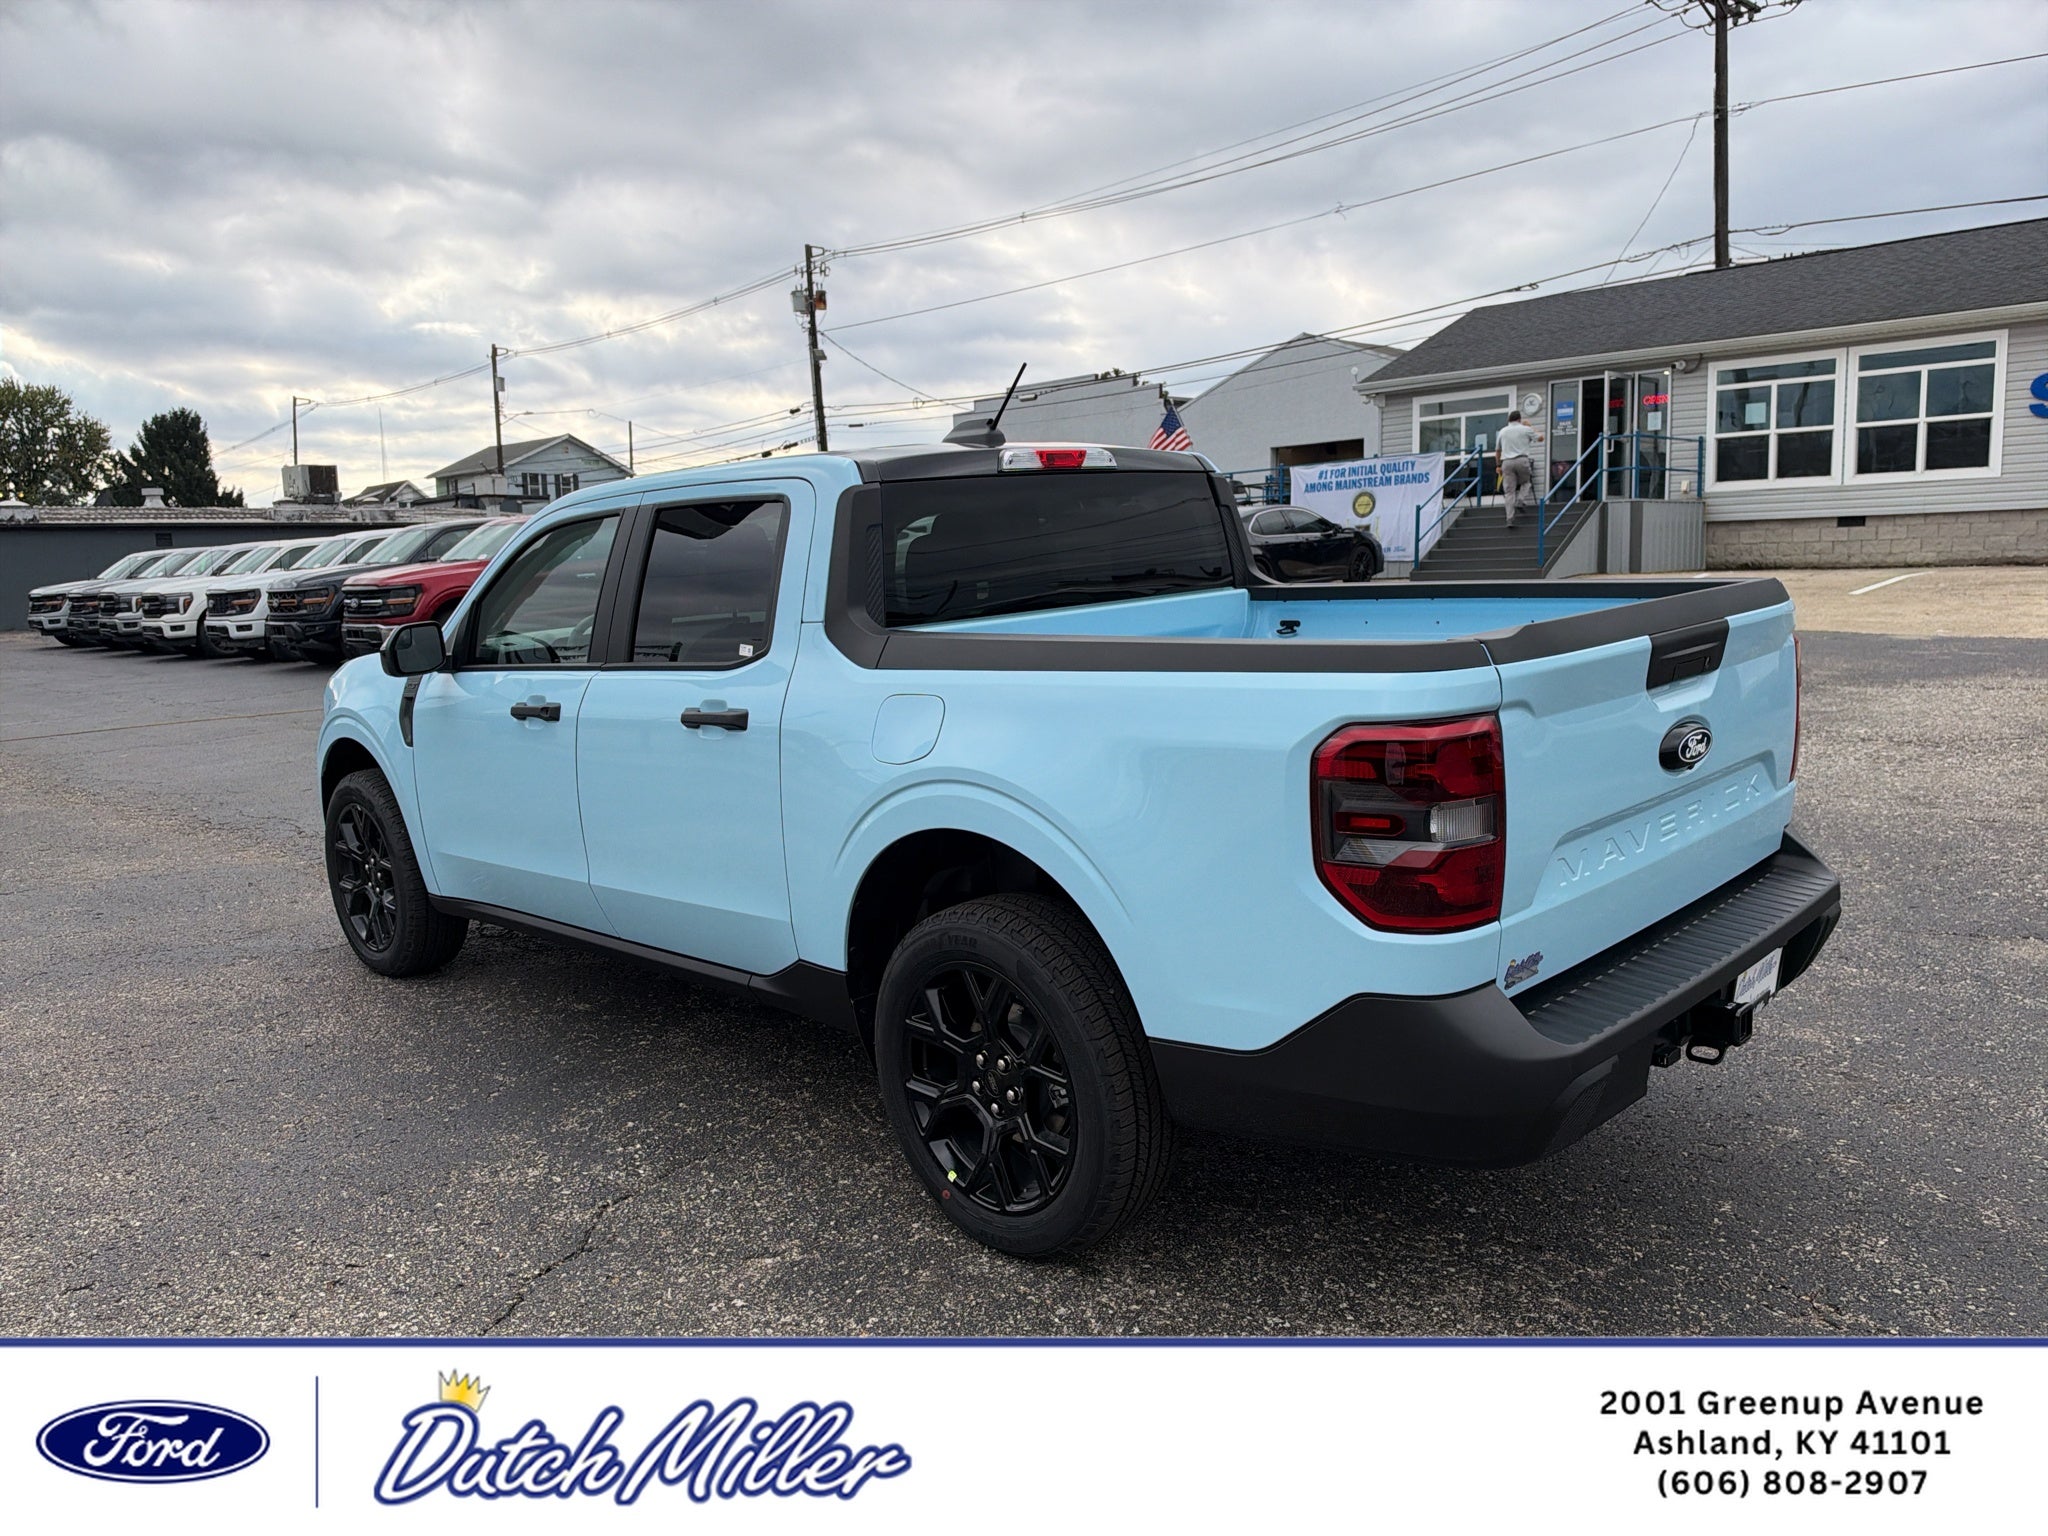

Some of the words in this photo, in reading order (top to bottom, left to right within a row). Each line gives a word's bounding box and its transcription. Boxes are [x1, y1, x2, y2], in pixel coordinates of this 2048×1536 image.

[1643, 394, 1669, 406] OPEN
[1317, 469, 1328, 480] #1
[1330, 467, 1347, 479] FOR
[1348, 464, 1378, 478] INITIAL
[1380, 460, 1416, 475] QUALITY
[1304, 482, 1334, 494] AMONG
[1335, 477, 1393, 491] MAINSTREAM
[1394, 472, 1431, 486] BRANDS
[1685, 733, 1708, 759] Ford
[1556, 773, 1762, 887] MAVERICK
